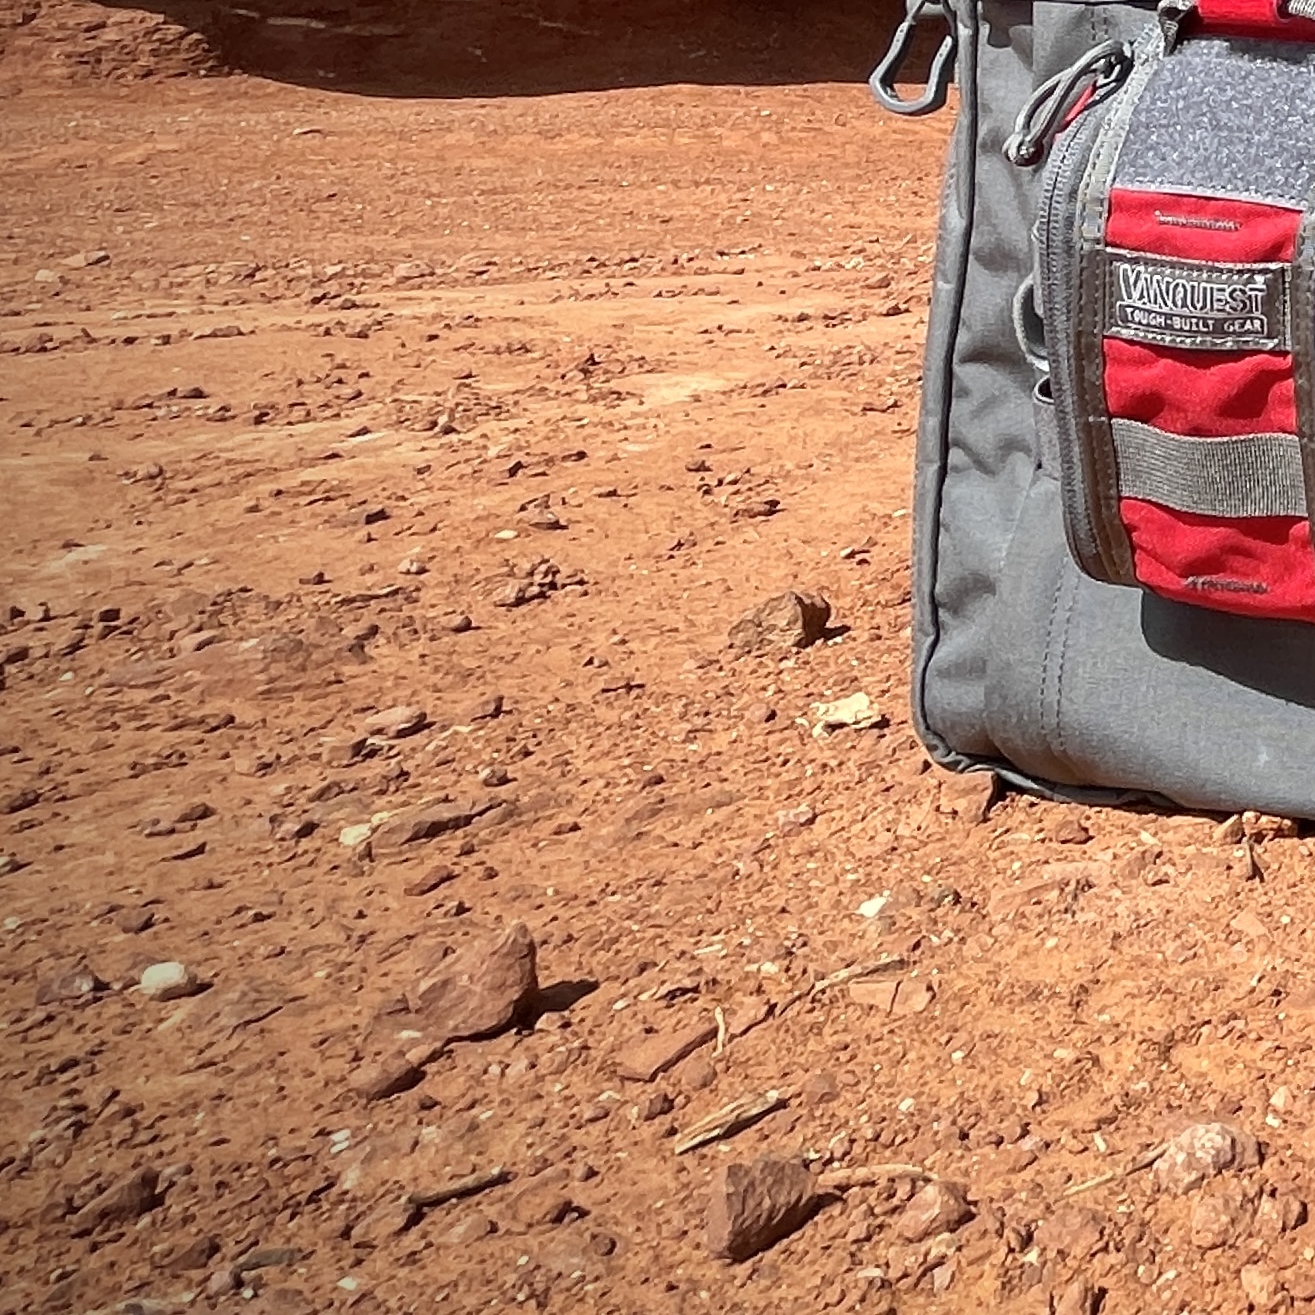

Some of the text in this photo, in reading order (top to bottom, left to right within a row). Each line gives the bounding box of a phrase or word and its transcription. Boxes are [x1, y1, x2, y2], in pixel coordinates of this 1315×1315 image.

[1119, 263, 1267, 316] VANQUEST
[1126, 307, 1263, 333] TOUGH-BUILT GEAR
